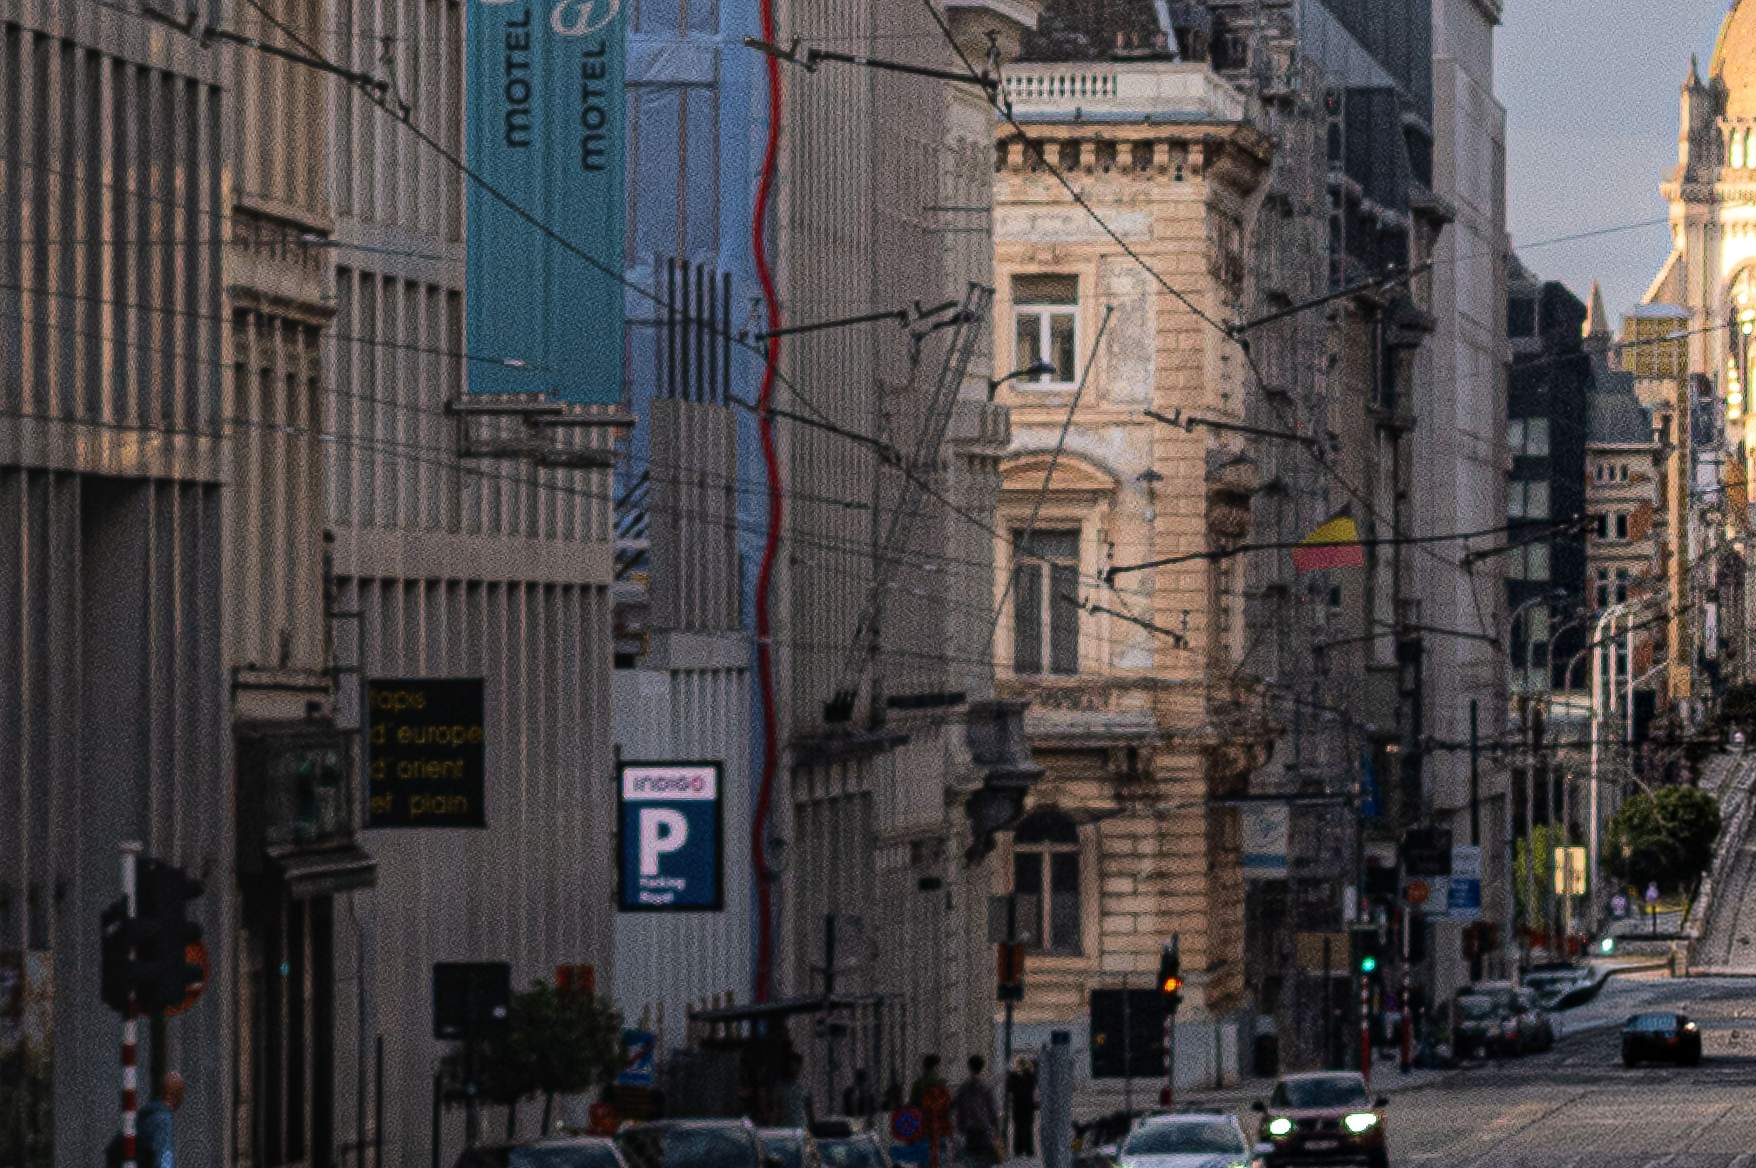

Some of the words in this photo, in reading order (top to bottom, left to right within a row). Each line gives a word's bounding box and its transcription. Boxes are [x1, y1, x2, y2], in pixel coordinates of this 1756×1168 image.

[505, 8, 532, 148] MOTEL
[581, 39, 608, 173] MOTEL
[640, 807, 689, 876] P
